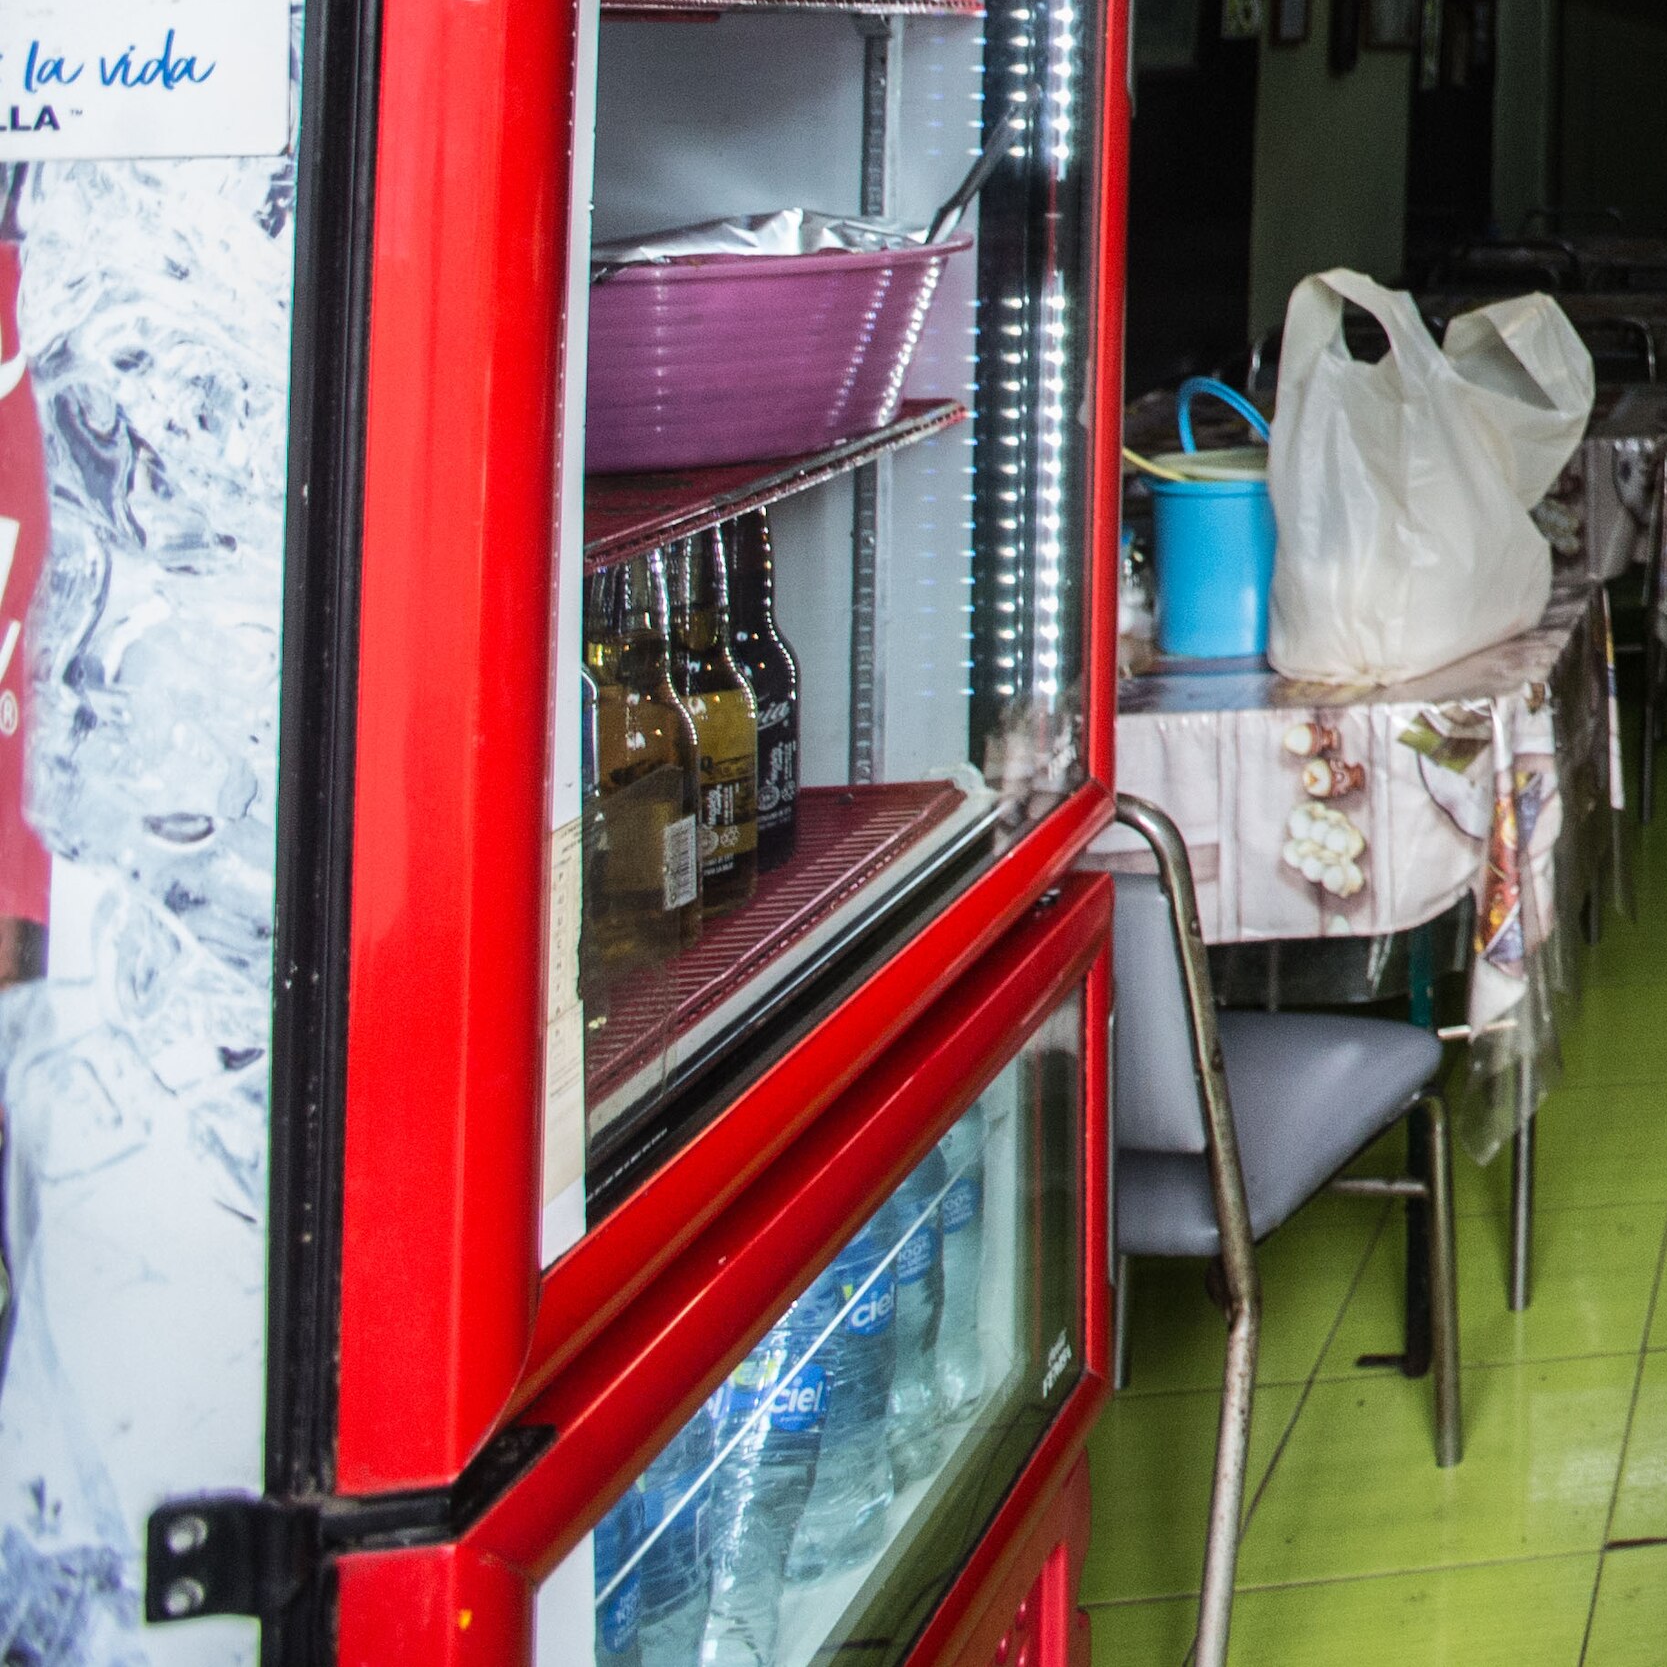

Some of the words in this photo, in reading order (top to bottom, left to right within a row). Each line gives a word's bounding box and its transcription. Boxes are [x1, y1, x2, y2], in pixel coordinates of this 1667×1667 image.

[24, 39, 84, 93] la
[100, 28, 217, 91] vida
[770, 1377, 825, 1414] ciel
